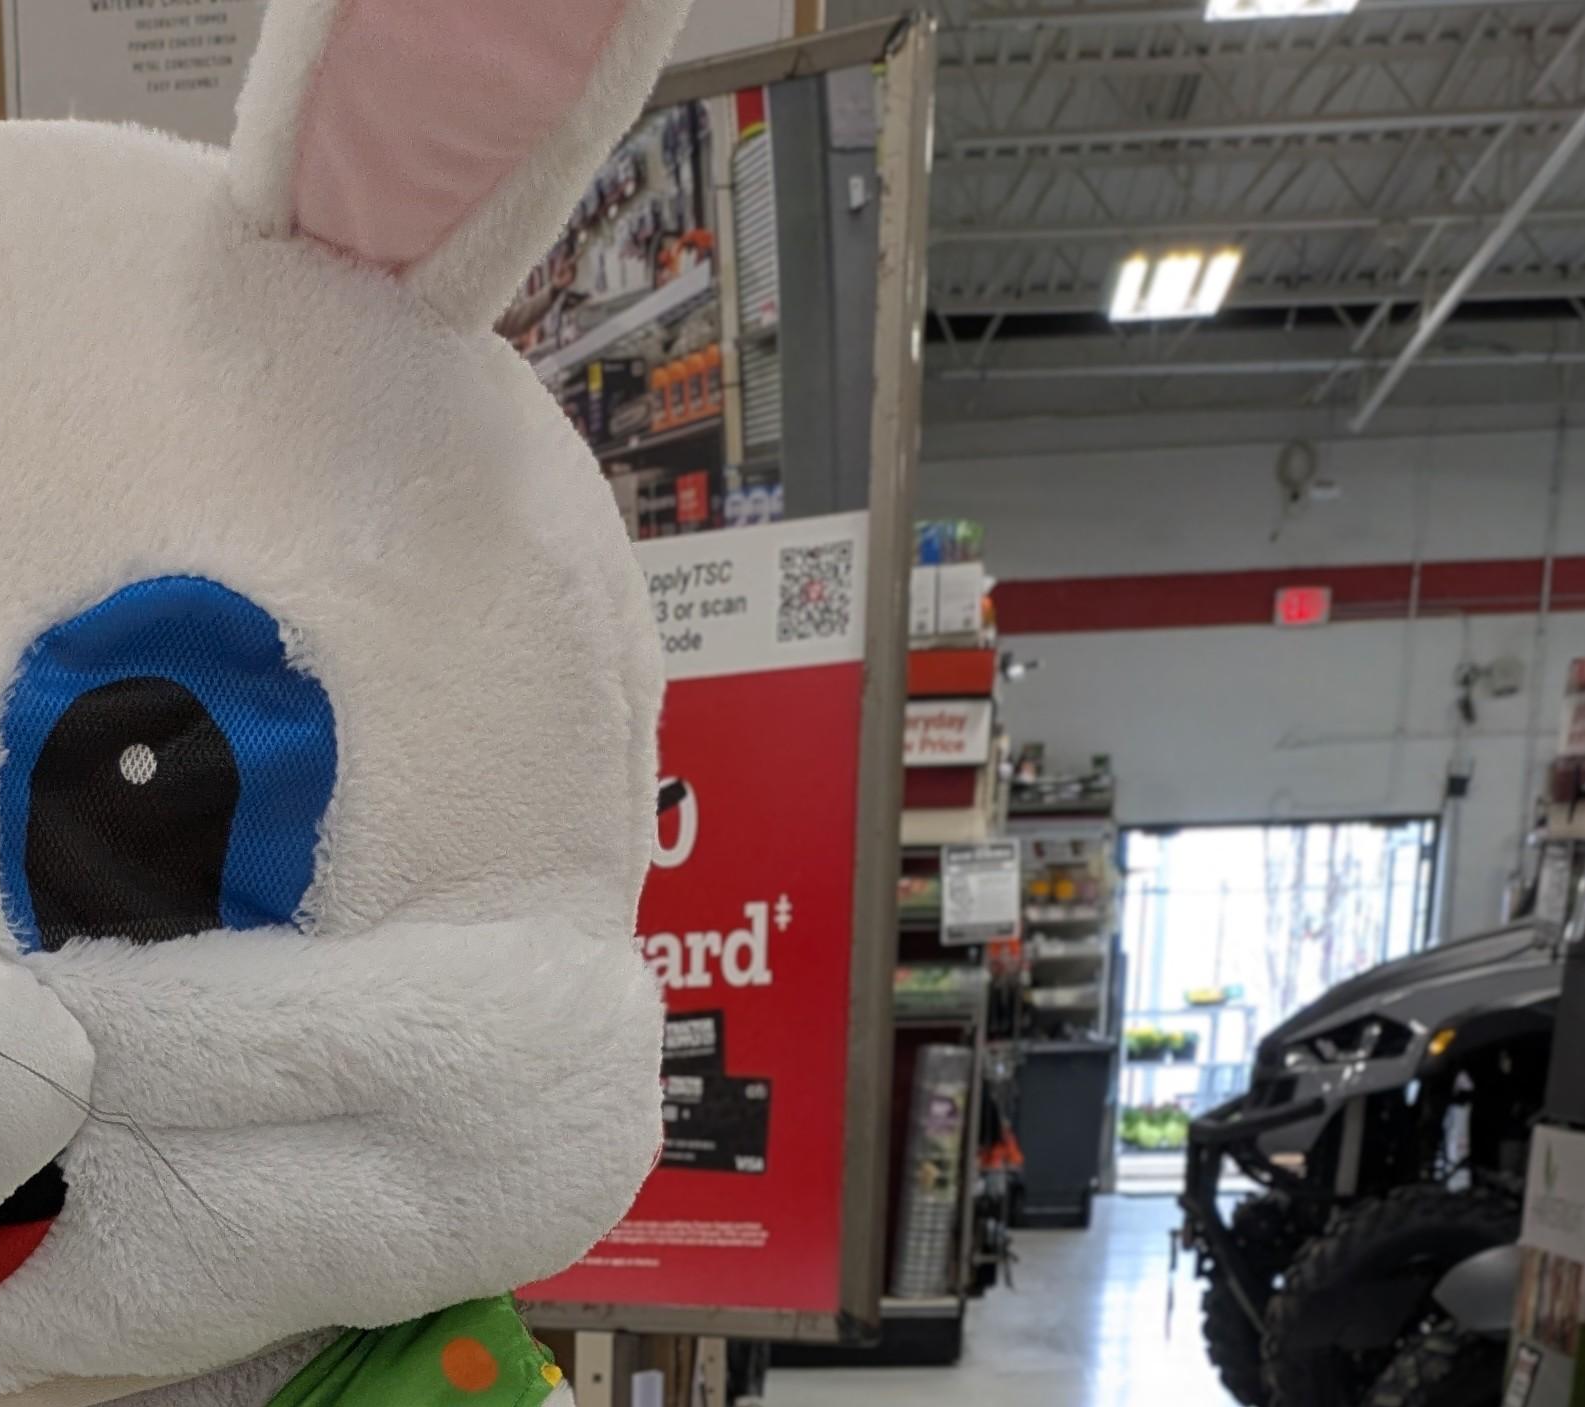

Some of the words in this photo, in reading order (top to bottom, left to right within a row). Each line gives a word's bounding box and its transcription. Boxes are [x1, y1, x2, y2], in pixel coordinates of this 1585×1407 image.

[645, 560, 733, 596] pplyTSC
[673, 602, 695, 621] or
[700, 596, 747, 619] scan
[660, 627, 703, 654] ode
